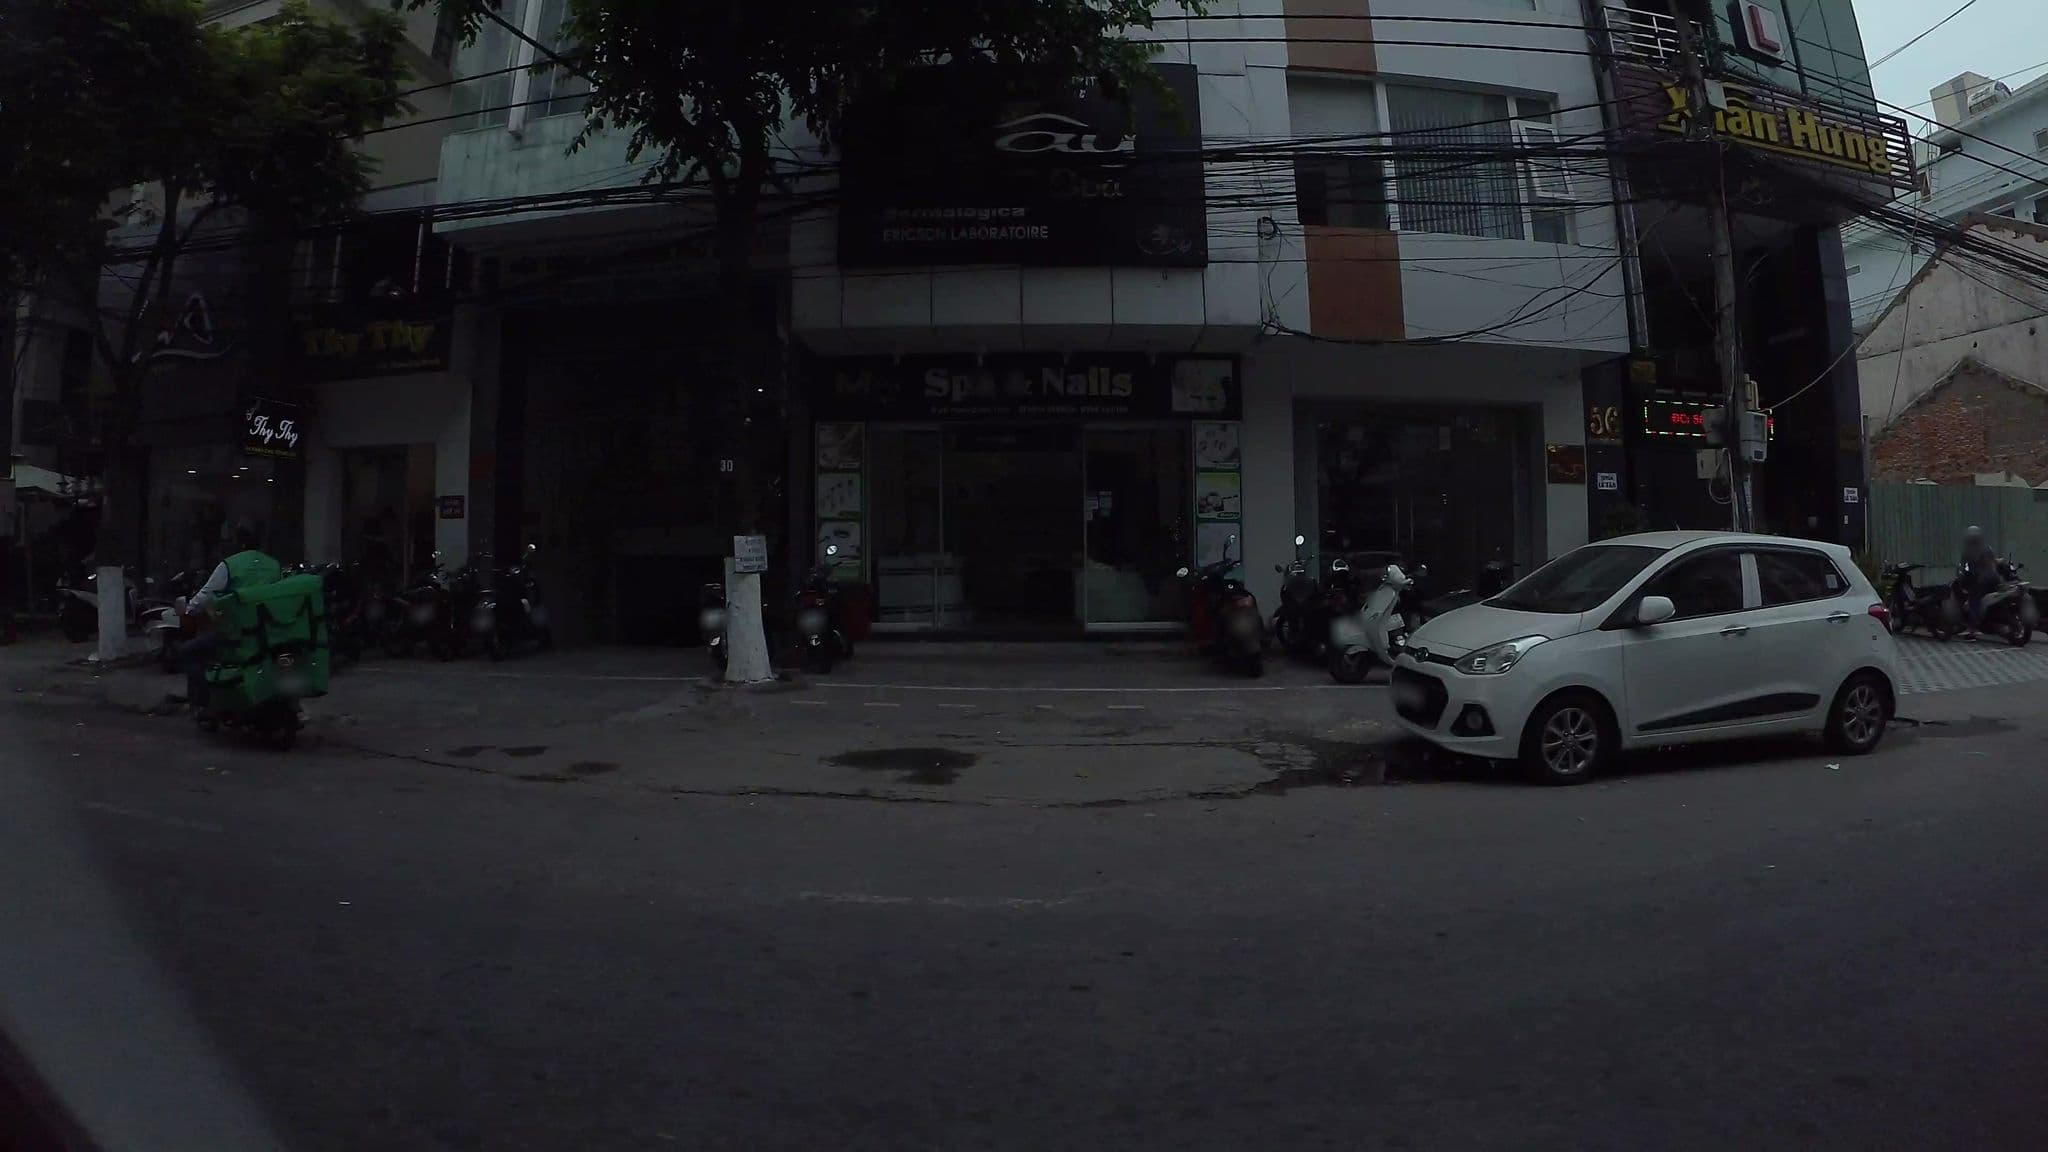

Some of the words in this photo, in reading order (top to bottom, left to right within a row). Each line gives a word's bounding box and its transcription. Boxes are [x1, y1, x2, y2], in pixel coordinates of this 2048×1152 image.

[1748, 5, 1779, 52] L
[1786, 107, 1891, 174] Hưng
[950, 226, 1048, 240] LABORATOIRE
[1041, 366, 1132, 397] Nails
[249, 415, 274, 445] Thy
[275, 420, 299, 449] Thy
